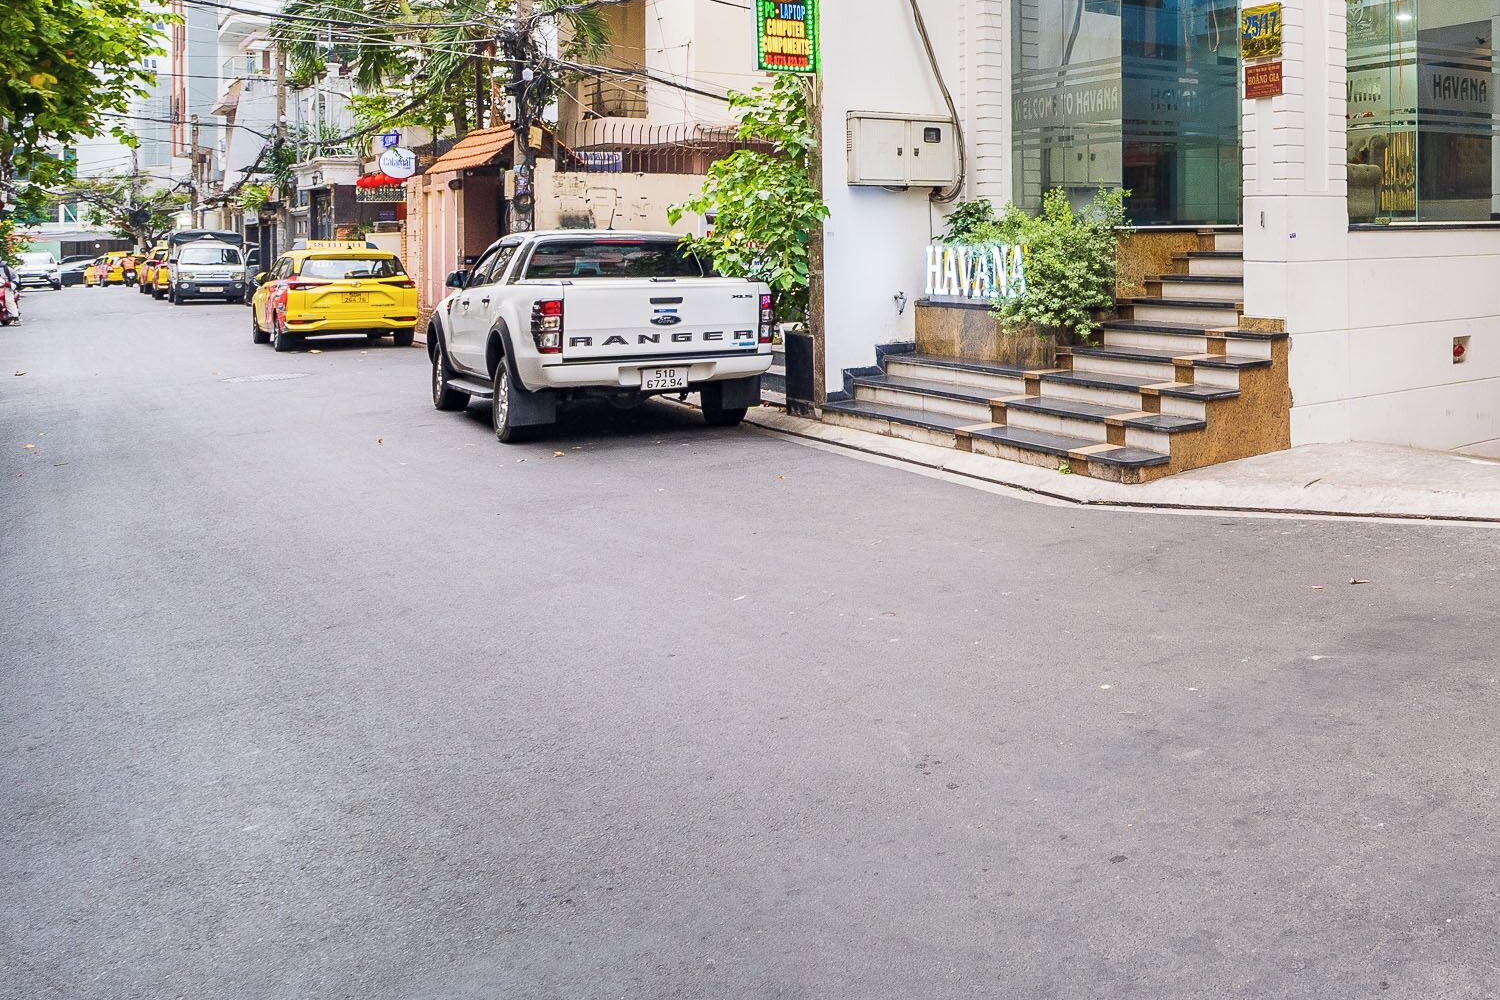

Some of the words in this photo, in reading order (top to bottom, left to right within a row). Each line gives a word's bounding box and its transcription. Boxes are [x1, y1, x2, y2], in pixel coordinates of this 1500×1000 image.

[764, 1, 775, 18] PC
[780, 3, 805, 20] LAPTOP
[766, 18, 805, 38] COMPUTER
[1245, 11, 1277, 39] 25/17
[762, 36, 810, 55] COMPONENTS
[1269, 73, 1280, 83] GIA
[1433, 74, 1487, 103] HAVANA
[1015, 94, 1057, 121] WELCOME
[1060, 93, 1072, 115] TO
[1076, 86, 1118, 115] HAVANA
[925, 244, 1029, 300] HAVANA
[569, 330, 754, 347] RANGER
[647, 377, 683, 389] 672.94
